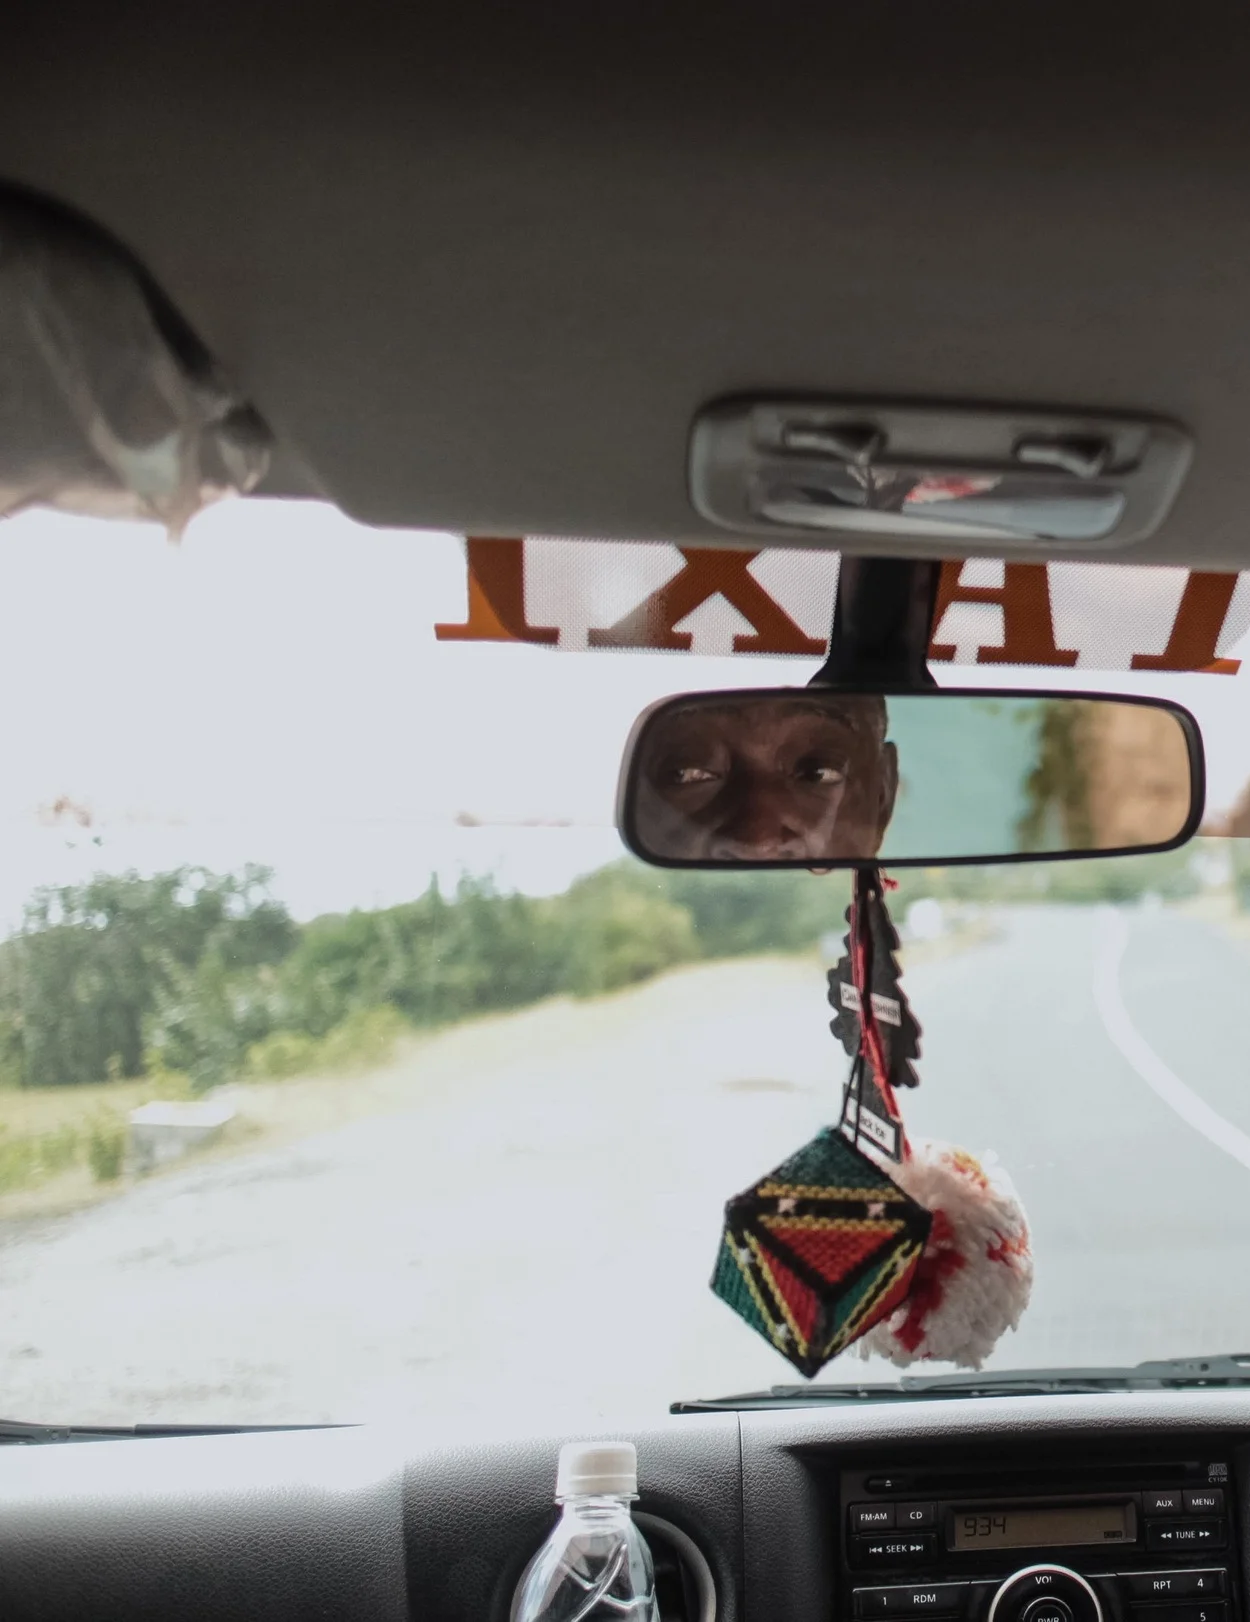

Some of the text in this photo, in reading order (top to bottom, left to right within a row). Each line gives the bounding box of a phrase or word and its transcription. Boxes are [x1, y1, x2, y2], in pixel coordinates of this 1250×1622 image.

[1156, 1500, 1174, 1508] AUX
[1192, 1498, 1216, 1506] MENU
[909, 1511, 923, 1520] CD
[964, 1516, 1007, 1538] 934
[1175, 1531, 1196, 1539] TUNE
[886, 1545, 908, 1553] SEEK
[1153, 1578, 1204, 1590] RPT 4
[883, 1594, 937, 1606] 1 RDM
[1200, 1612, 1207, 1622] 5
